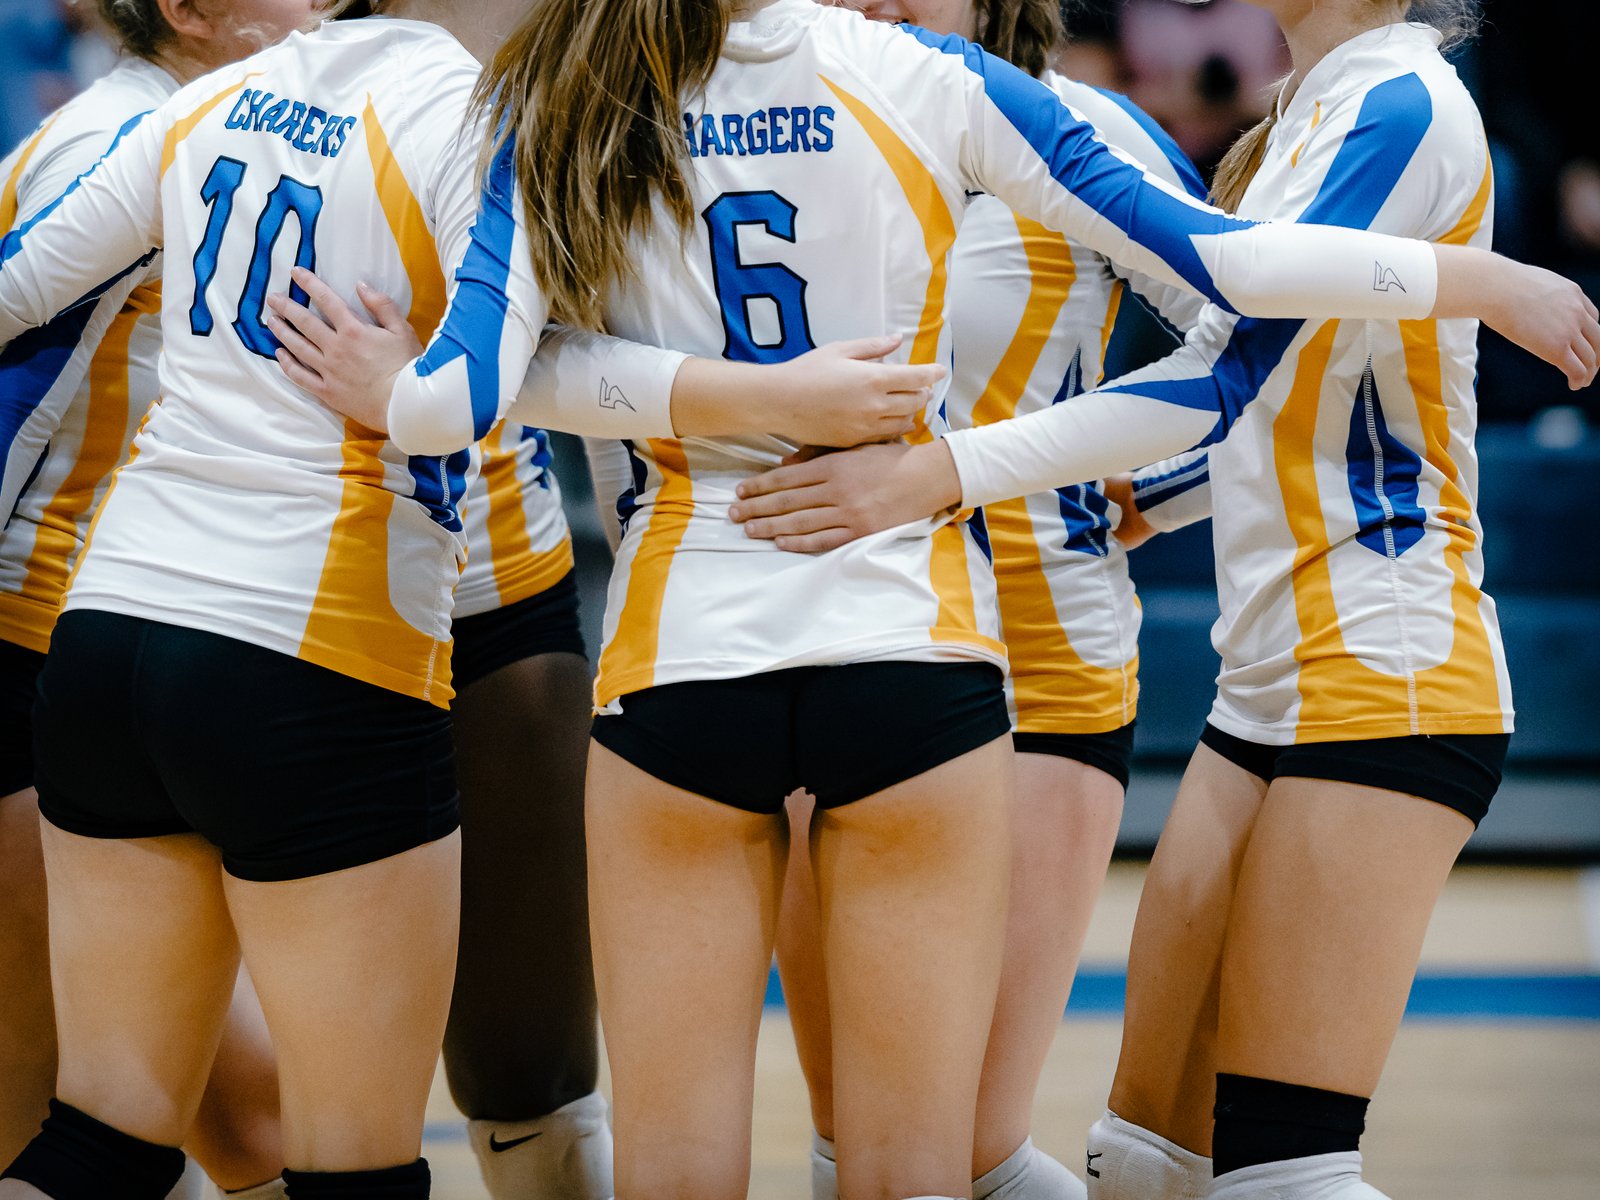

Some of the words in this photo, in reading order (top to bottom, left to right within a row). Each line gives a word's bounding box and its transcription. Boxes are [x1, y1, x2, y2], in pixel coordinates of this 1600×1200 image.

[225, 88, 357, 158] CHARERS
[683, 106, 836, 158] ARGERS
[189, 155, 324, 363] 10
[701, 189, 818, 365] 6
